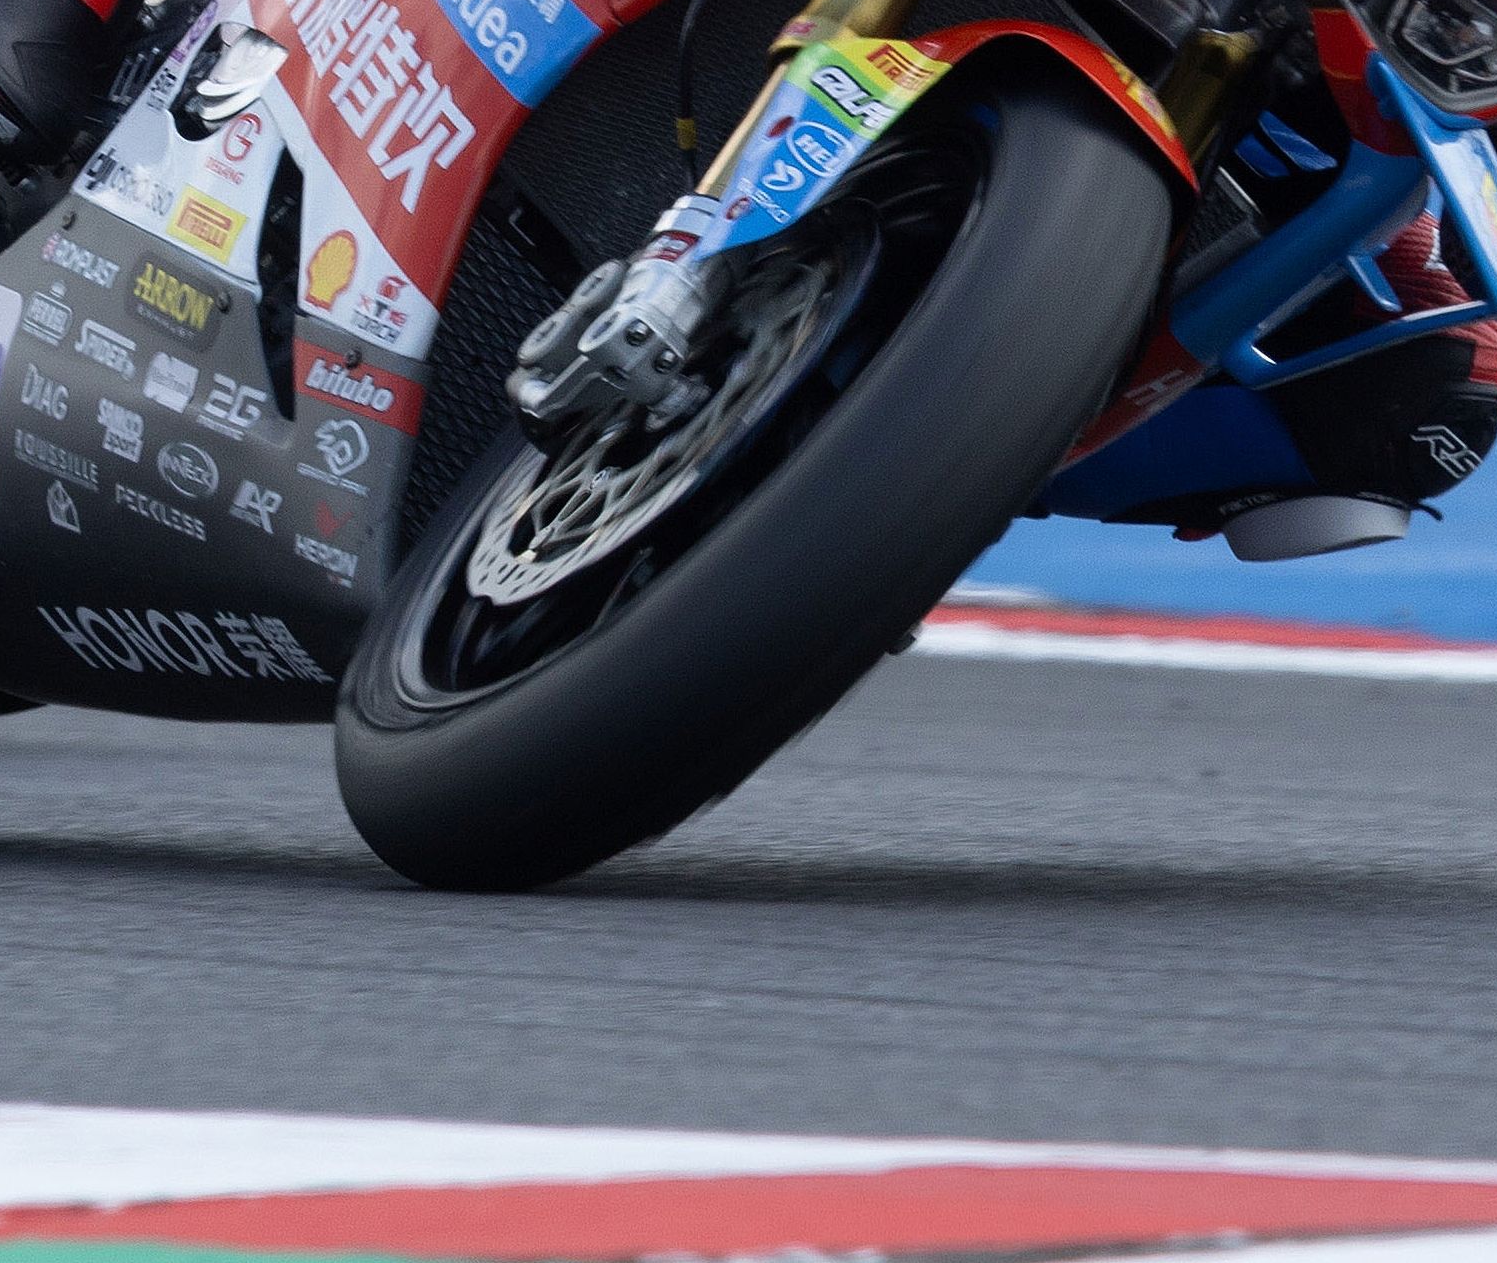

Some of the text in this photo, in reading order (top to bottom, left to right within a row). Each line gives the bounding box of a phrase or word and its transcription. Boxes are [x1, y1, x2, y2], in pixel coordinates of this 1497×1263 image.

[133, 261, 216, 332] ARROW
[1410, 422, 1483, 481] RS
[36, 605, 254, 680] HONOR
